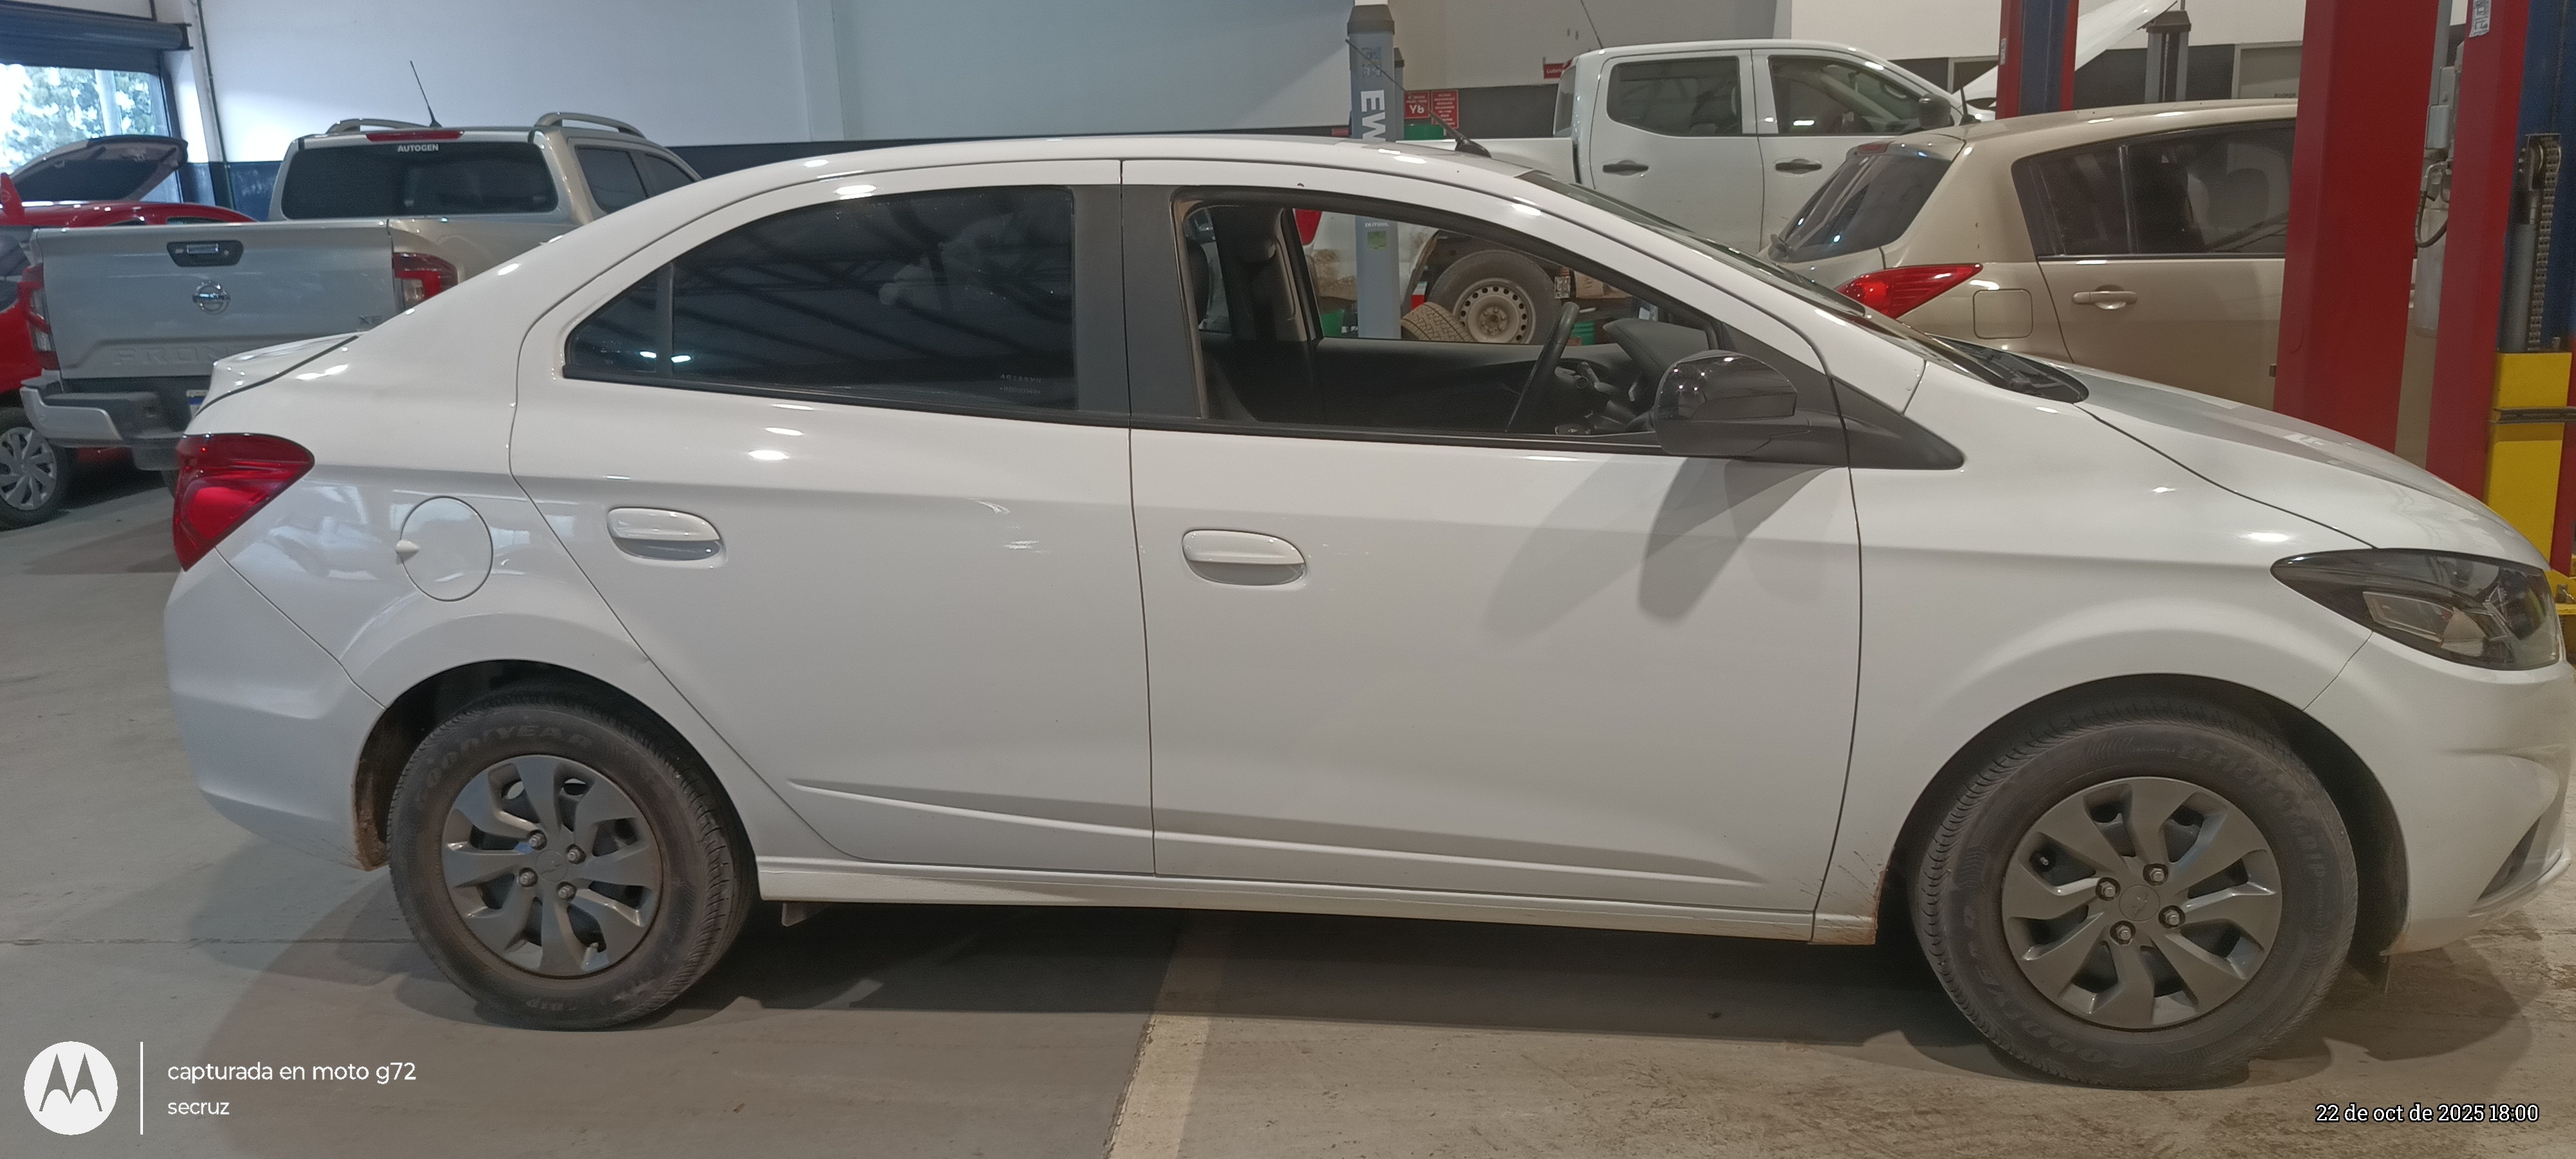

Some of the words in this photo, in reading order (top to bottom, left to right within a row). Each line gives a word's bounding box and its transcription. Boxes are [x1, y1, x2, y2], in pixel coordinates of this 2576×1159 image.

[1360, 90, 1387, 142] EW
[397, 144, 439, 153] AUTOGEN
[112, 344, 250, 365] FRON
